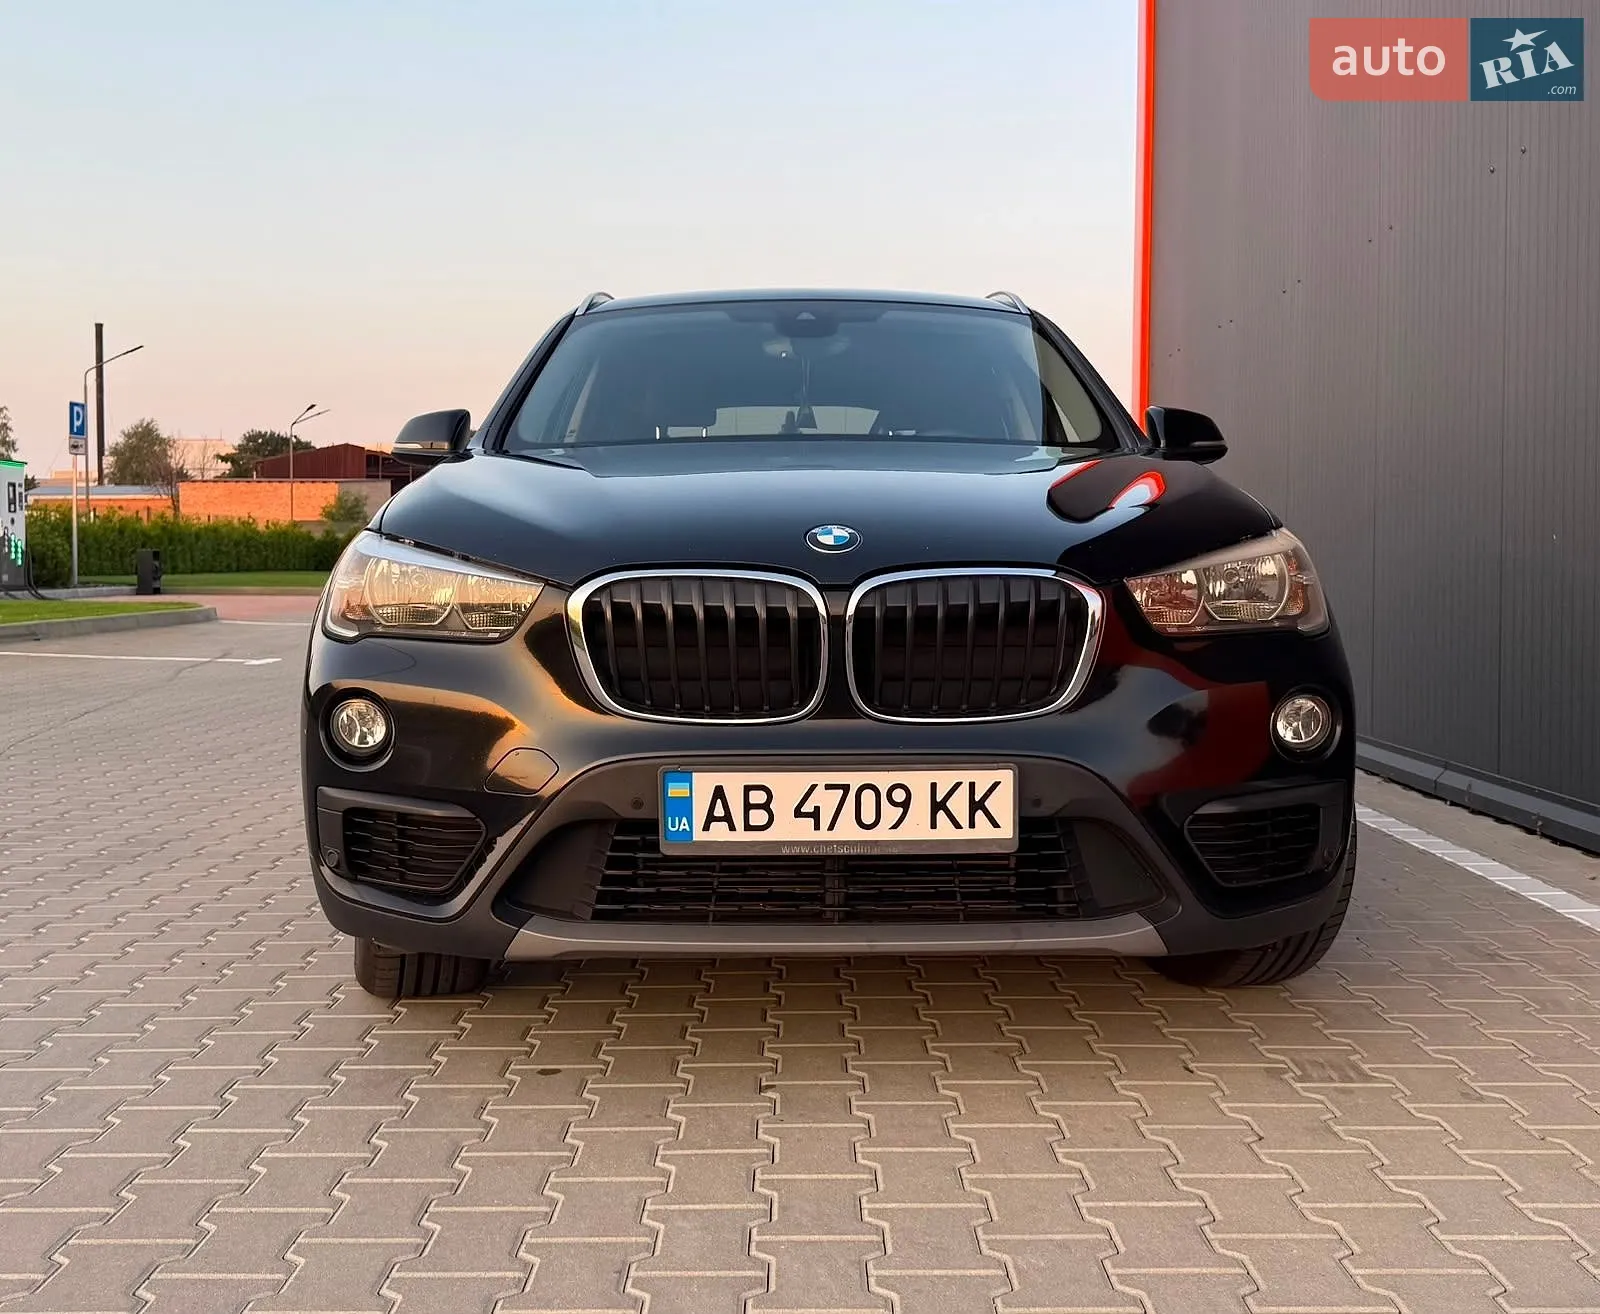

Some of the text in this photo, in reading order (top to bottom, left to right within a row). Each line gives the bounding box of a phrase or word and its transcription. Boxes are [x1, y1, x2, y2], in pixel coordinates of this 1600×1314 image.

[73, 405, 83, 433] P
[701, 781, 1002, 832] AB 4709 KK
[667, 816, 690, 831] UA
